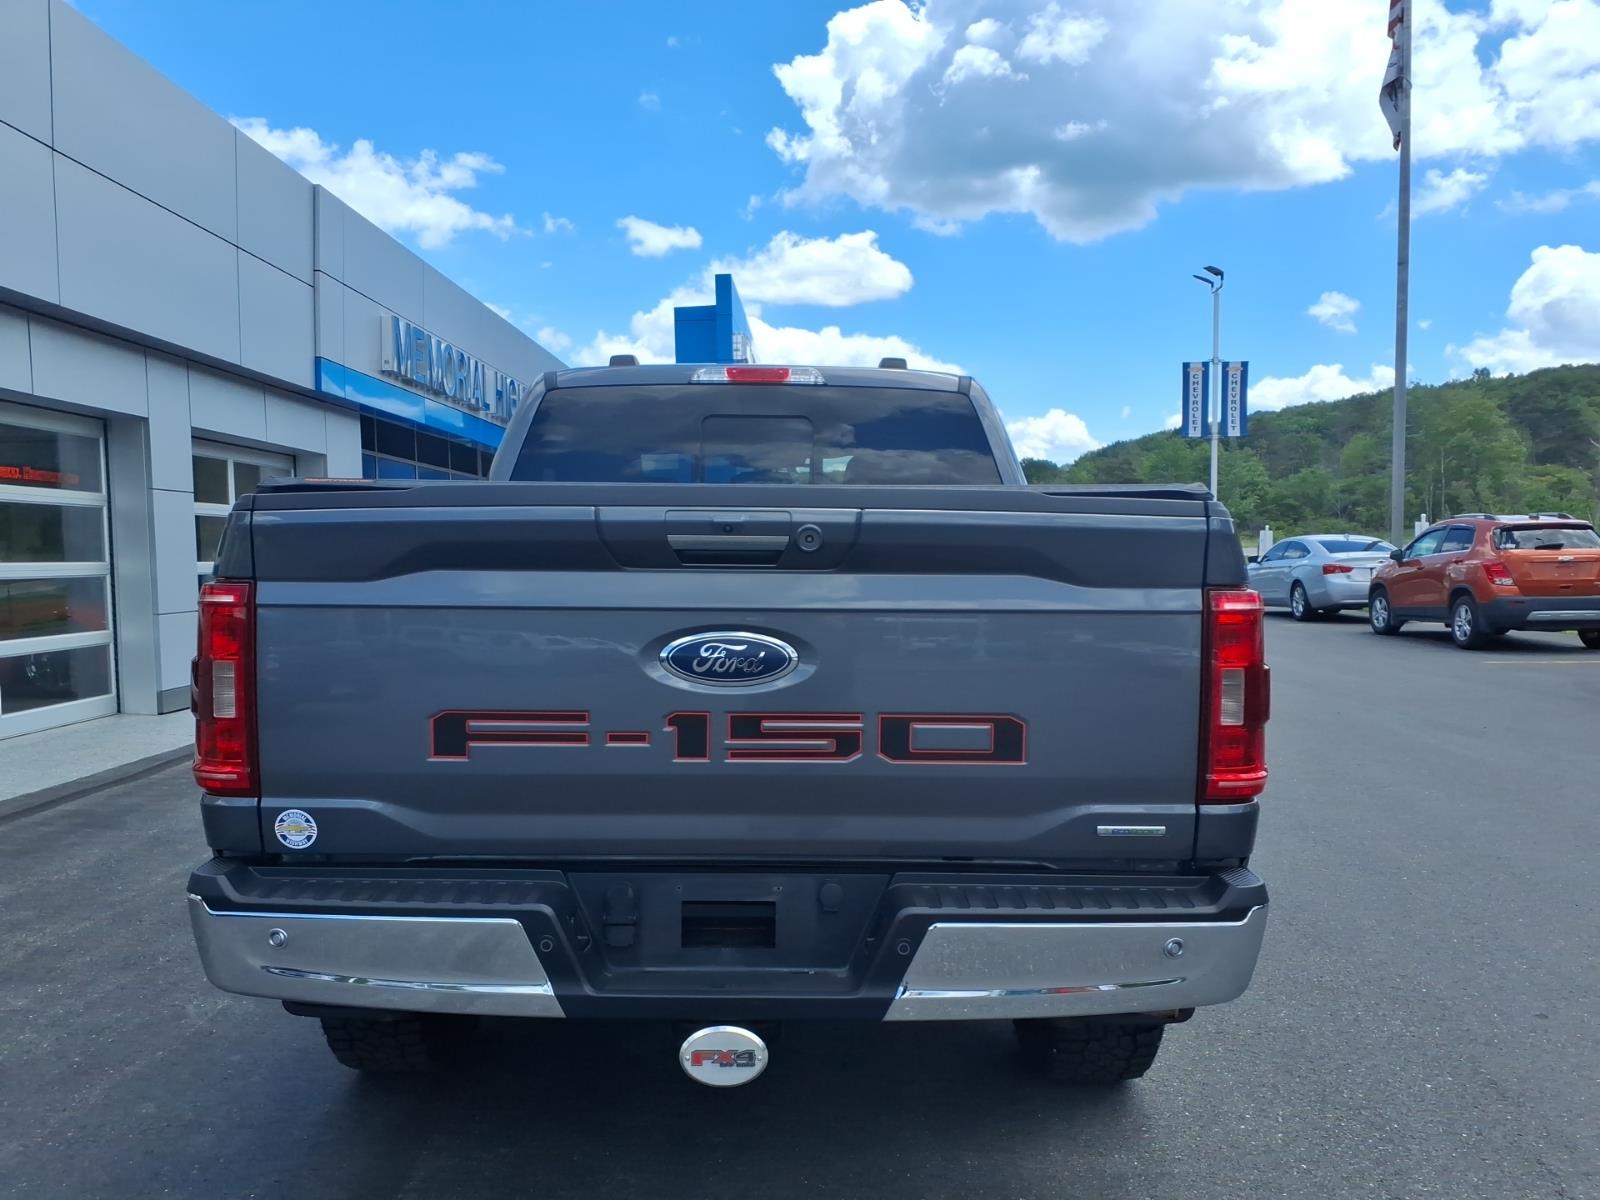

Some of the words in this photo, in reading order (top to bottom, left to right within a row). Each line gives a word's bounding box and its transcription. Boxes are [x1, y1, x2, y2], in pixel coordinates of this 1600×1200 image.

[392, 316, 490, 411] MEMORIAL
[1192, 374, 1200, 432] CHEVROLET
[1230, 373, 1238, 431] CHEVROLET
[692, 642, 765, 673] Ford
[427, 709, 1027, 764] F-150
[690, 1049, 756, 1067] FX4
